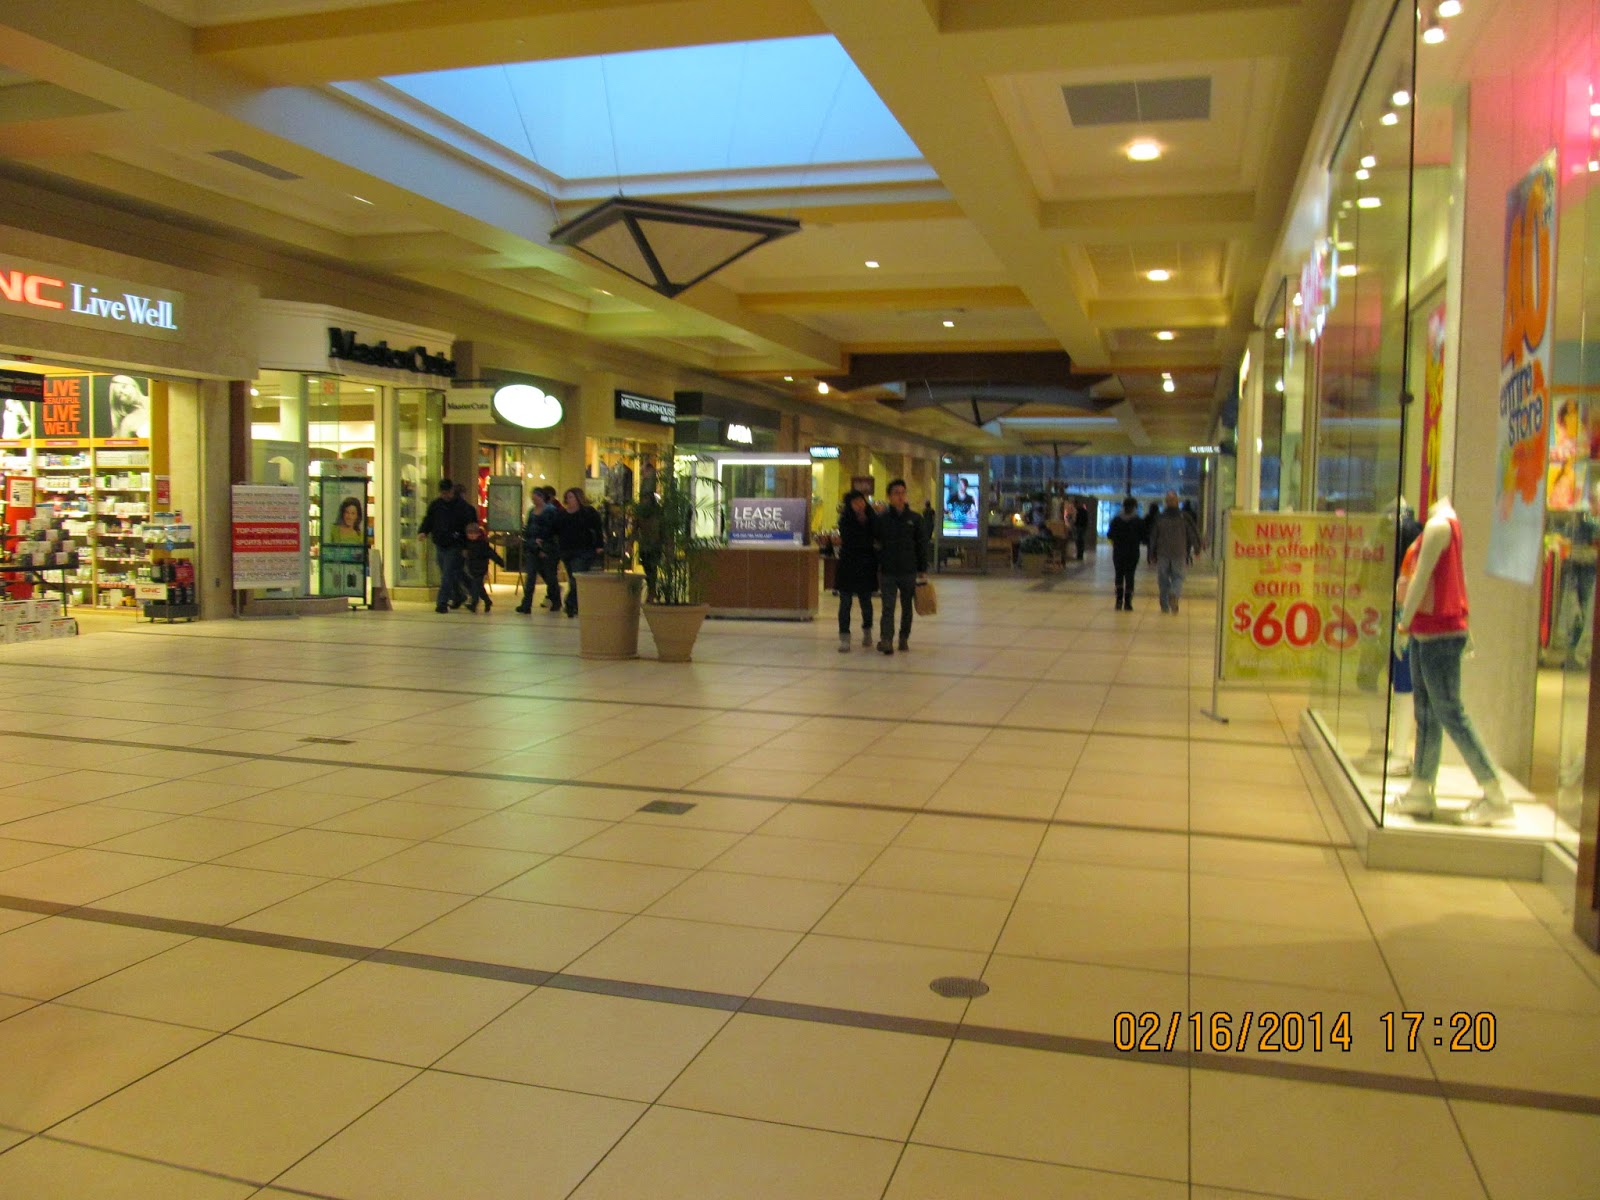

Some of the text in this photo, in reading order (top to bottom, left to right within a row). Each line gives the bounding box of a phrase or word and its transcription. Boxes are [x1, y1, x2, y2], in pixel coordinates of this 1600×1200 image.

[44, 379, 80, 397] LIVE
[43, 404, 81, 421] LIVE
[1508, 394, 1542, 447] store
[43, 421, 80, 435] WELL
[734, 506, 783, 520] LEASE
[734, 520, 791, 531] THIS SPACE
[1256, 522, 1301, 540] NEW!
[1234, 541, 1272, 559] best
[1253, 579, 1301, 597] earn
[1233, 602, 1318, 647] $60
